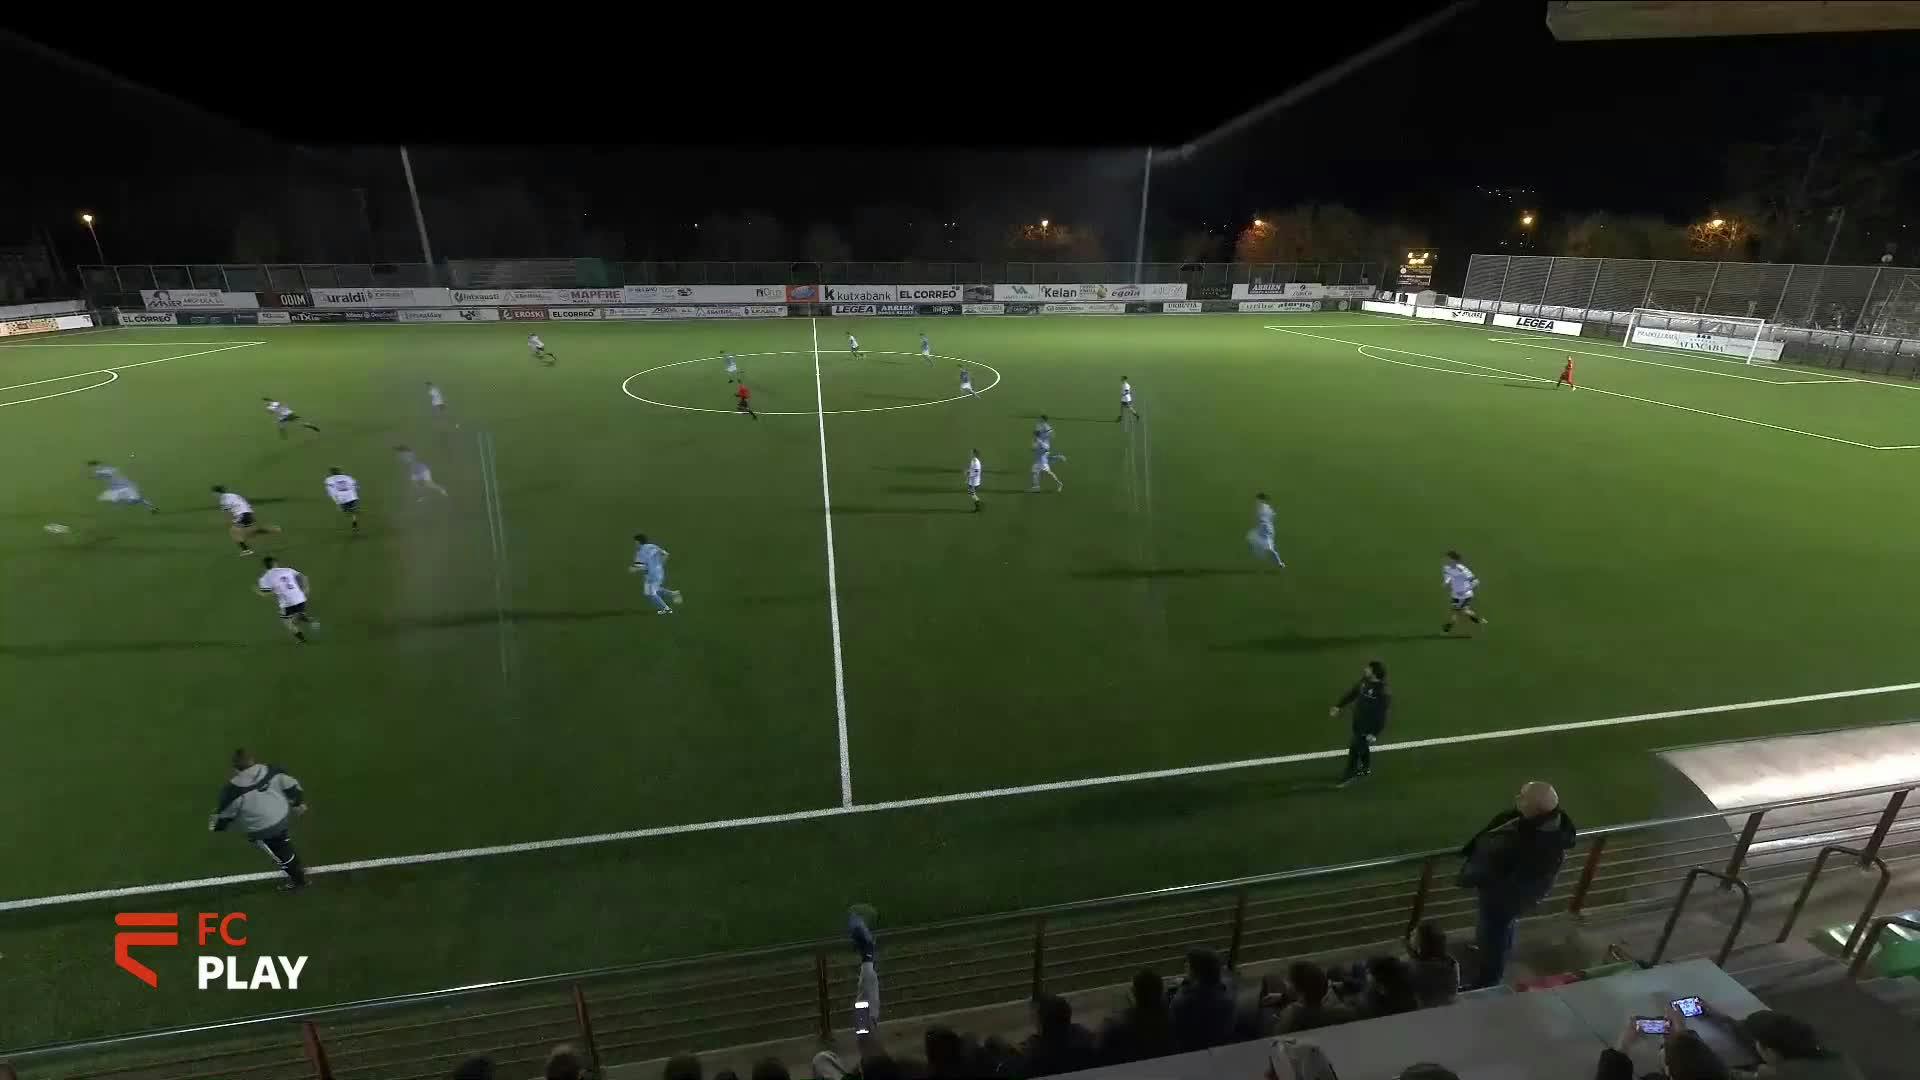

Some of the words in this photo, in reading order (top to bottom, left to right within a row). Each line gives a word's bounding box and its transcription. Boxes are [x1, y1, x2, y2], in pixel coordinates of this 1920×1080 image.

[837, 291, 891, 301] kutxabank
[900, 291, 913, 299] EL
[914, 290, 957, 299] CORREO
[1044, 288, 1077, 298] Kelan
[835, 305, 874, 314] LEGEA
[1516, 317, 1555, 330] LEGEA
